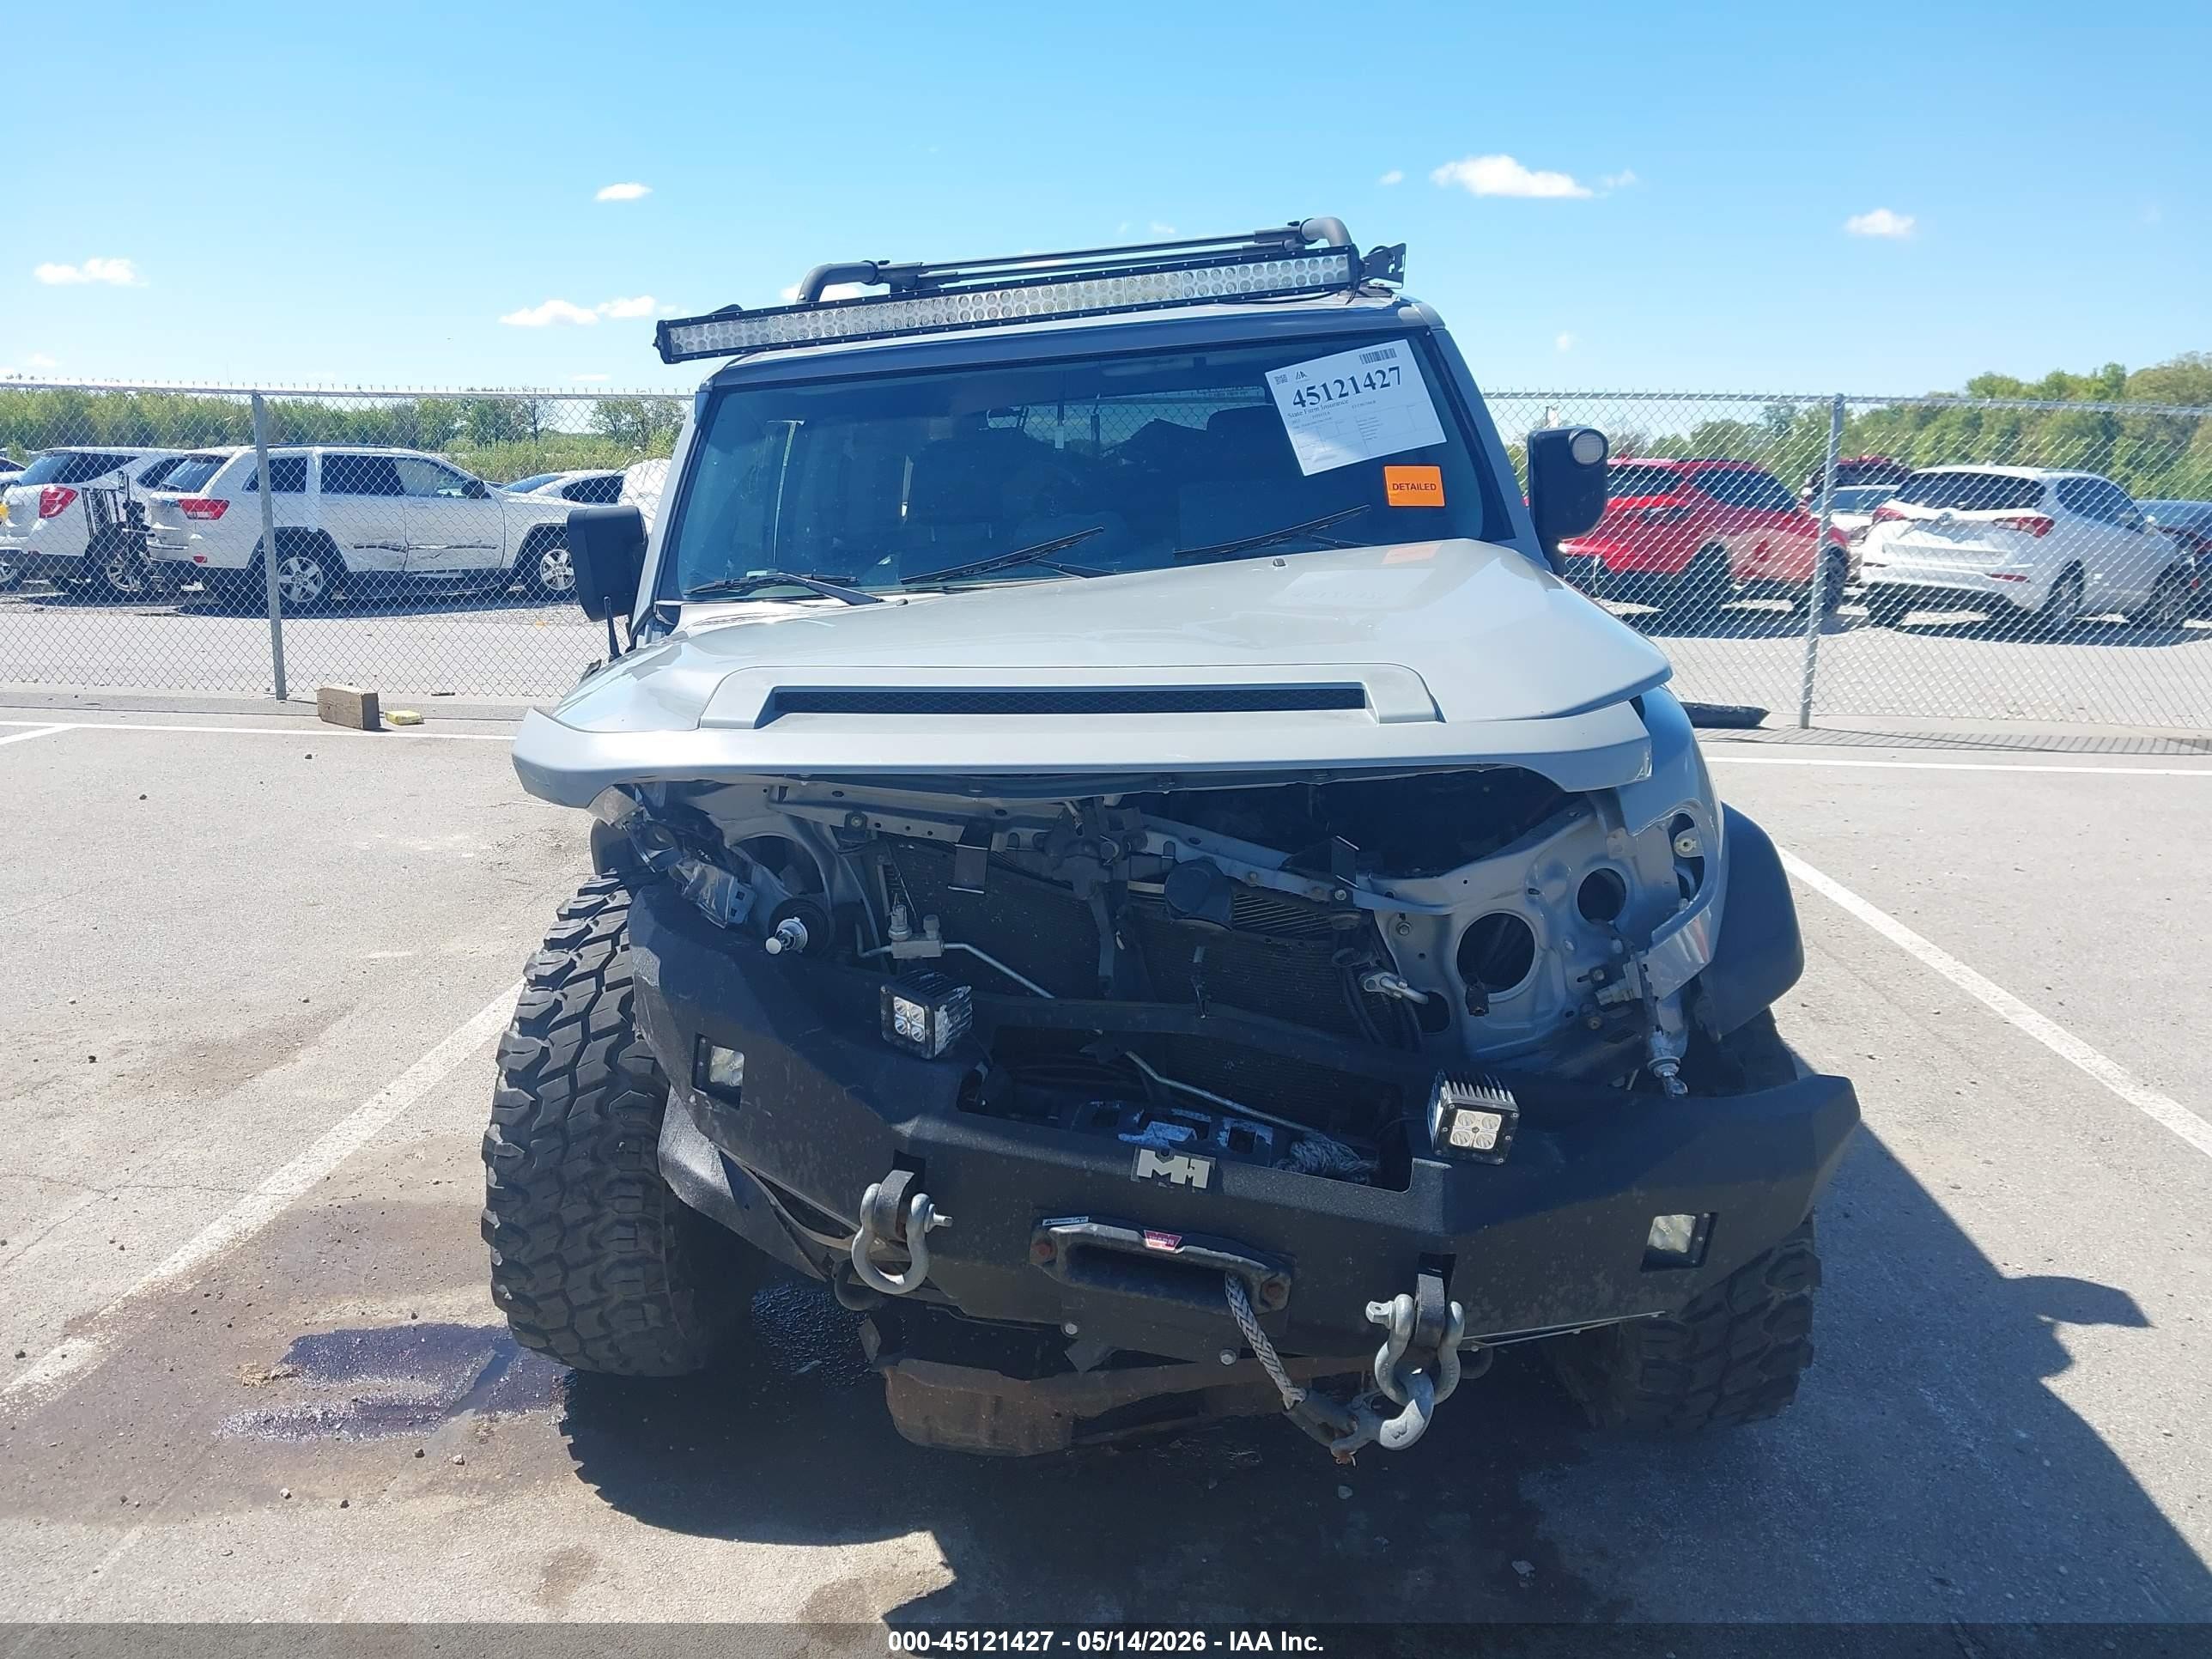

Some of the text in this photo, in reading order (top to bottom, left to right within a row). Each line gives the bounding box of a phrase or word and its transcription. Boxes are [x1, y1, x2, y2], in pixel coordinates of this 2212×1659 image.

[1292, 366, 1401, 408] 45121427
[1287, 410, 1304, 419] State
[1392, 483, 1437, 491] DETAILED
